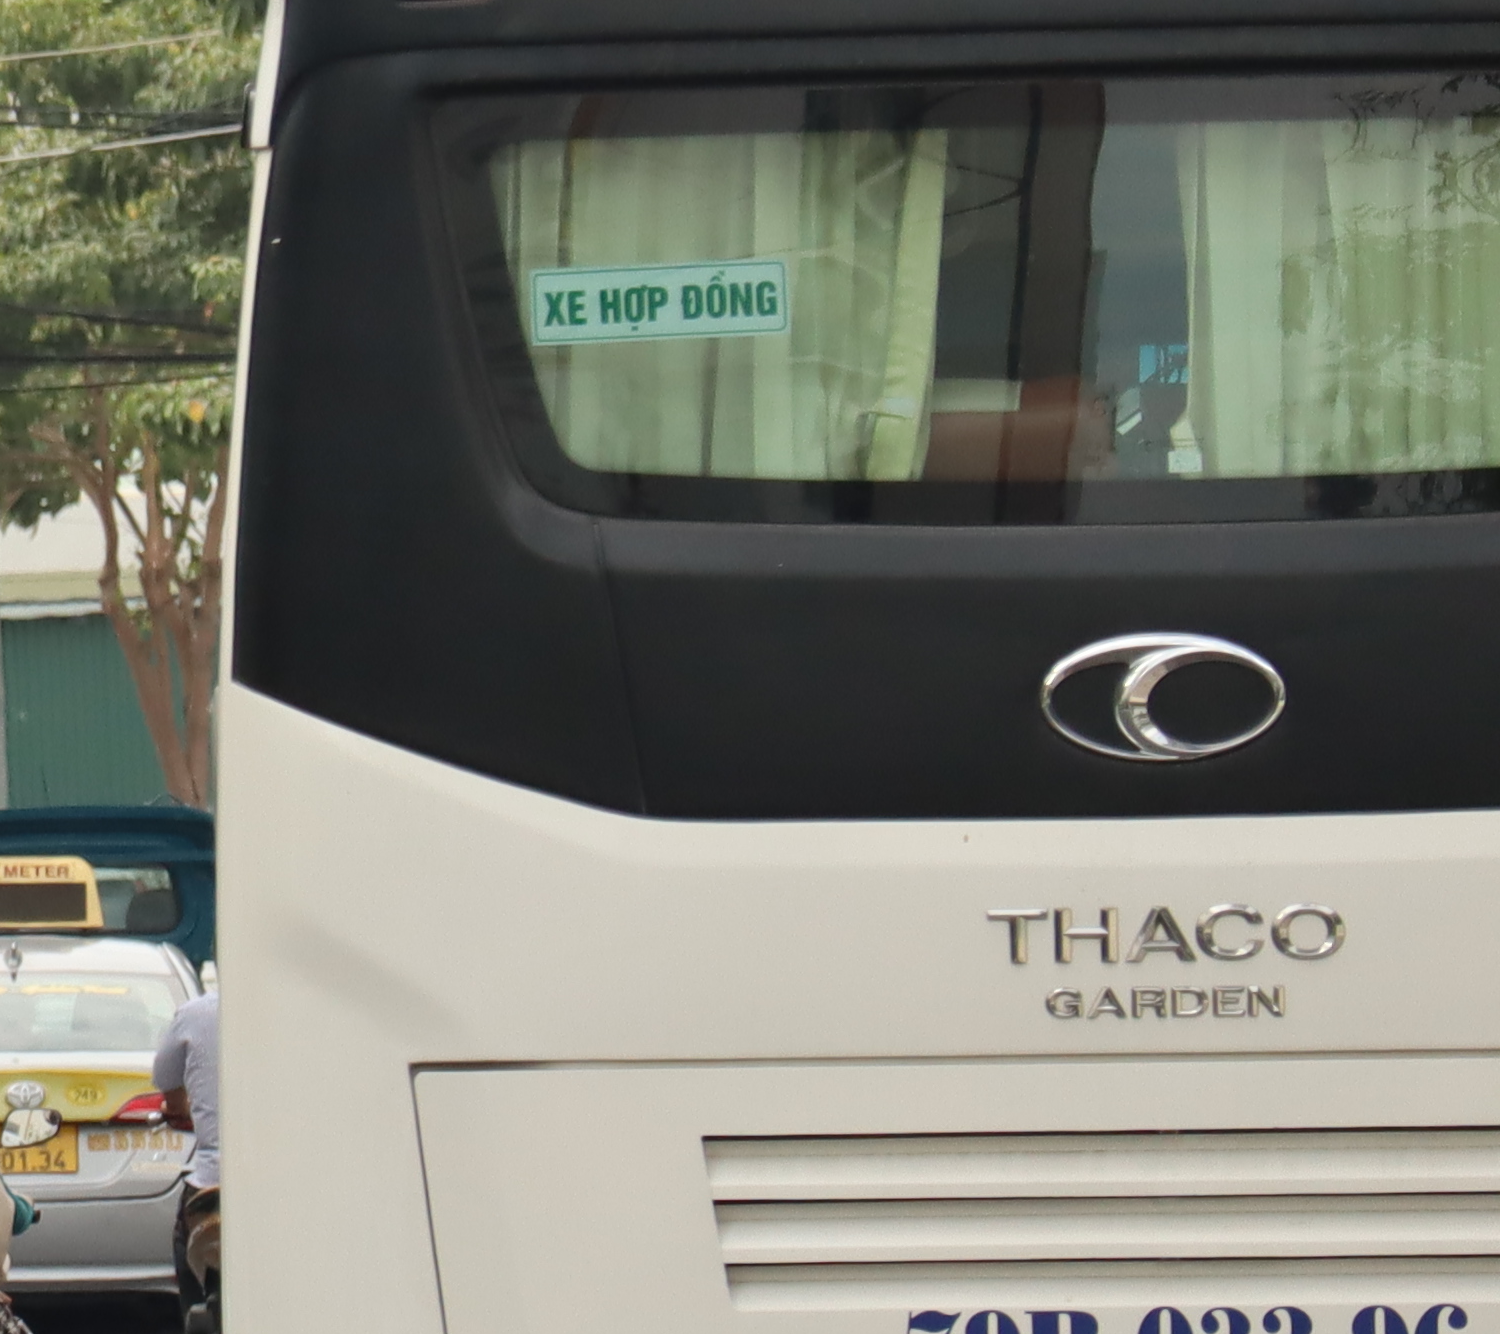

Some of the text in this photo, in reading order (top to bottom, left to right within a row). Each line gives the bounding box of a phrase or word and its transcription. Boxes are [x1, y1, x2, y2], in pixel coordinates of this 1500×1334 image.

[543, 269, 777, 332] XE HỢP ĐỒNG
[3, 864, 69, 880] METER
[986, 903, 1346, 965] THACO
[1045, 985, 1286, 1018] GARDEN
